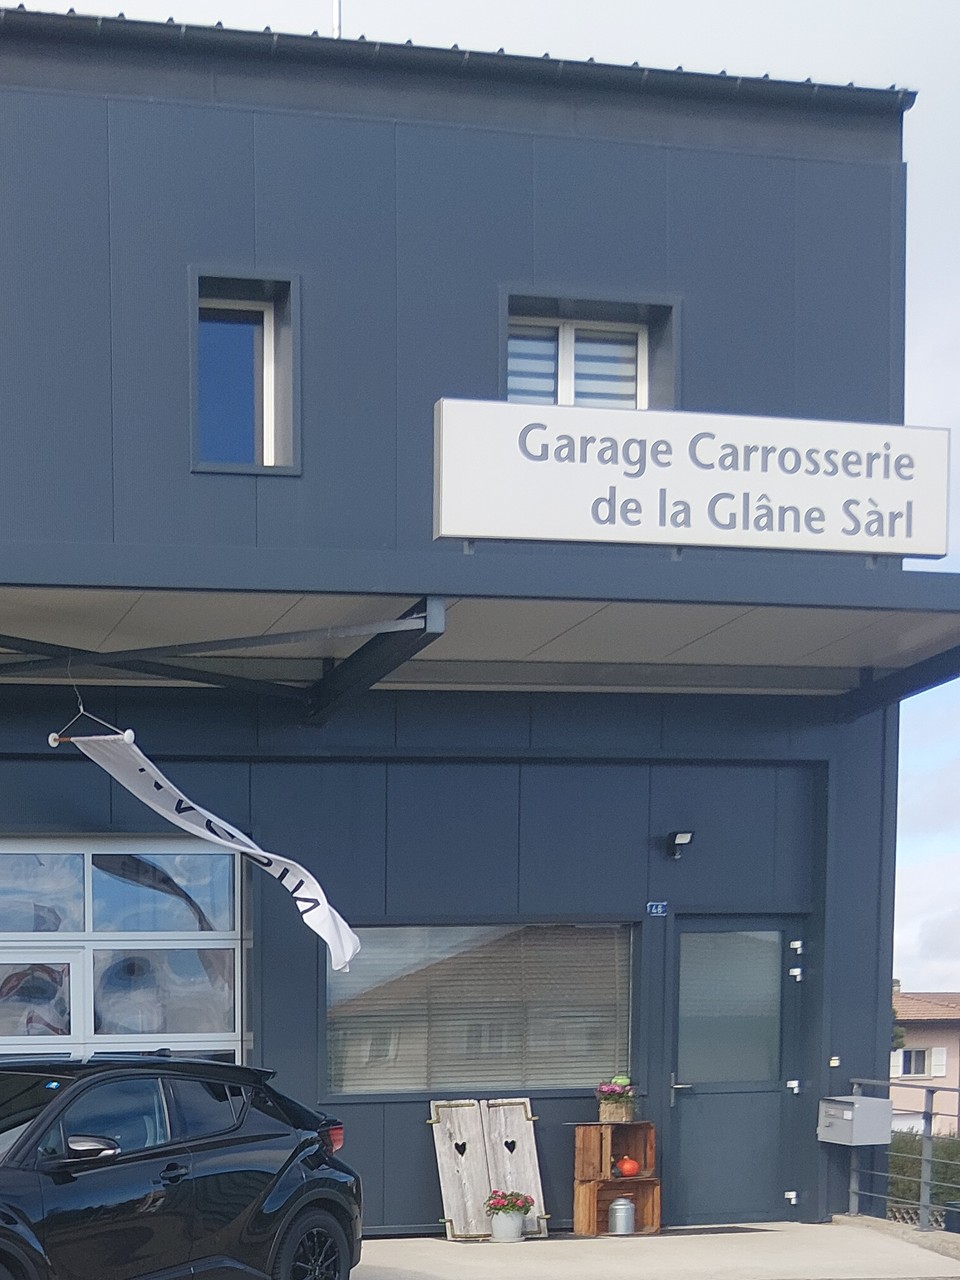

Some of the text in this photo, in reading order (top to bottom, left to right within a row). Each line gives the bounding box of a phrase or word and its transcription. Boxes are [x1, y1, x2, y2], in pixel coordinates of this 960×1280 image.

[517, 422, 916, 481] Garage Carrosserie
[590, 486, 913, 539] de la Glâne Sàrl
